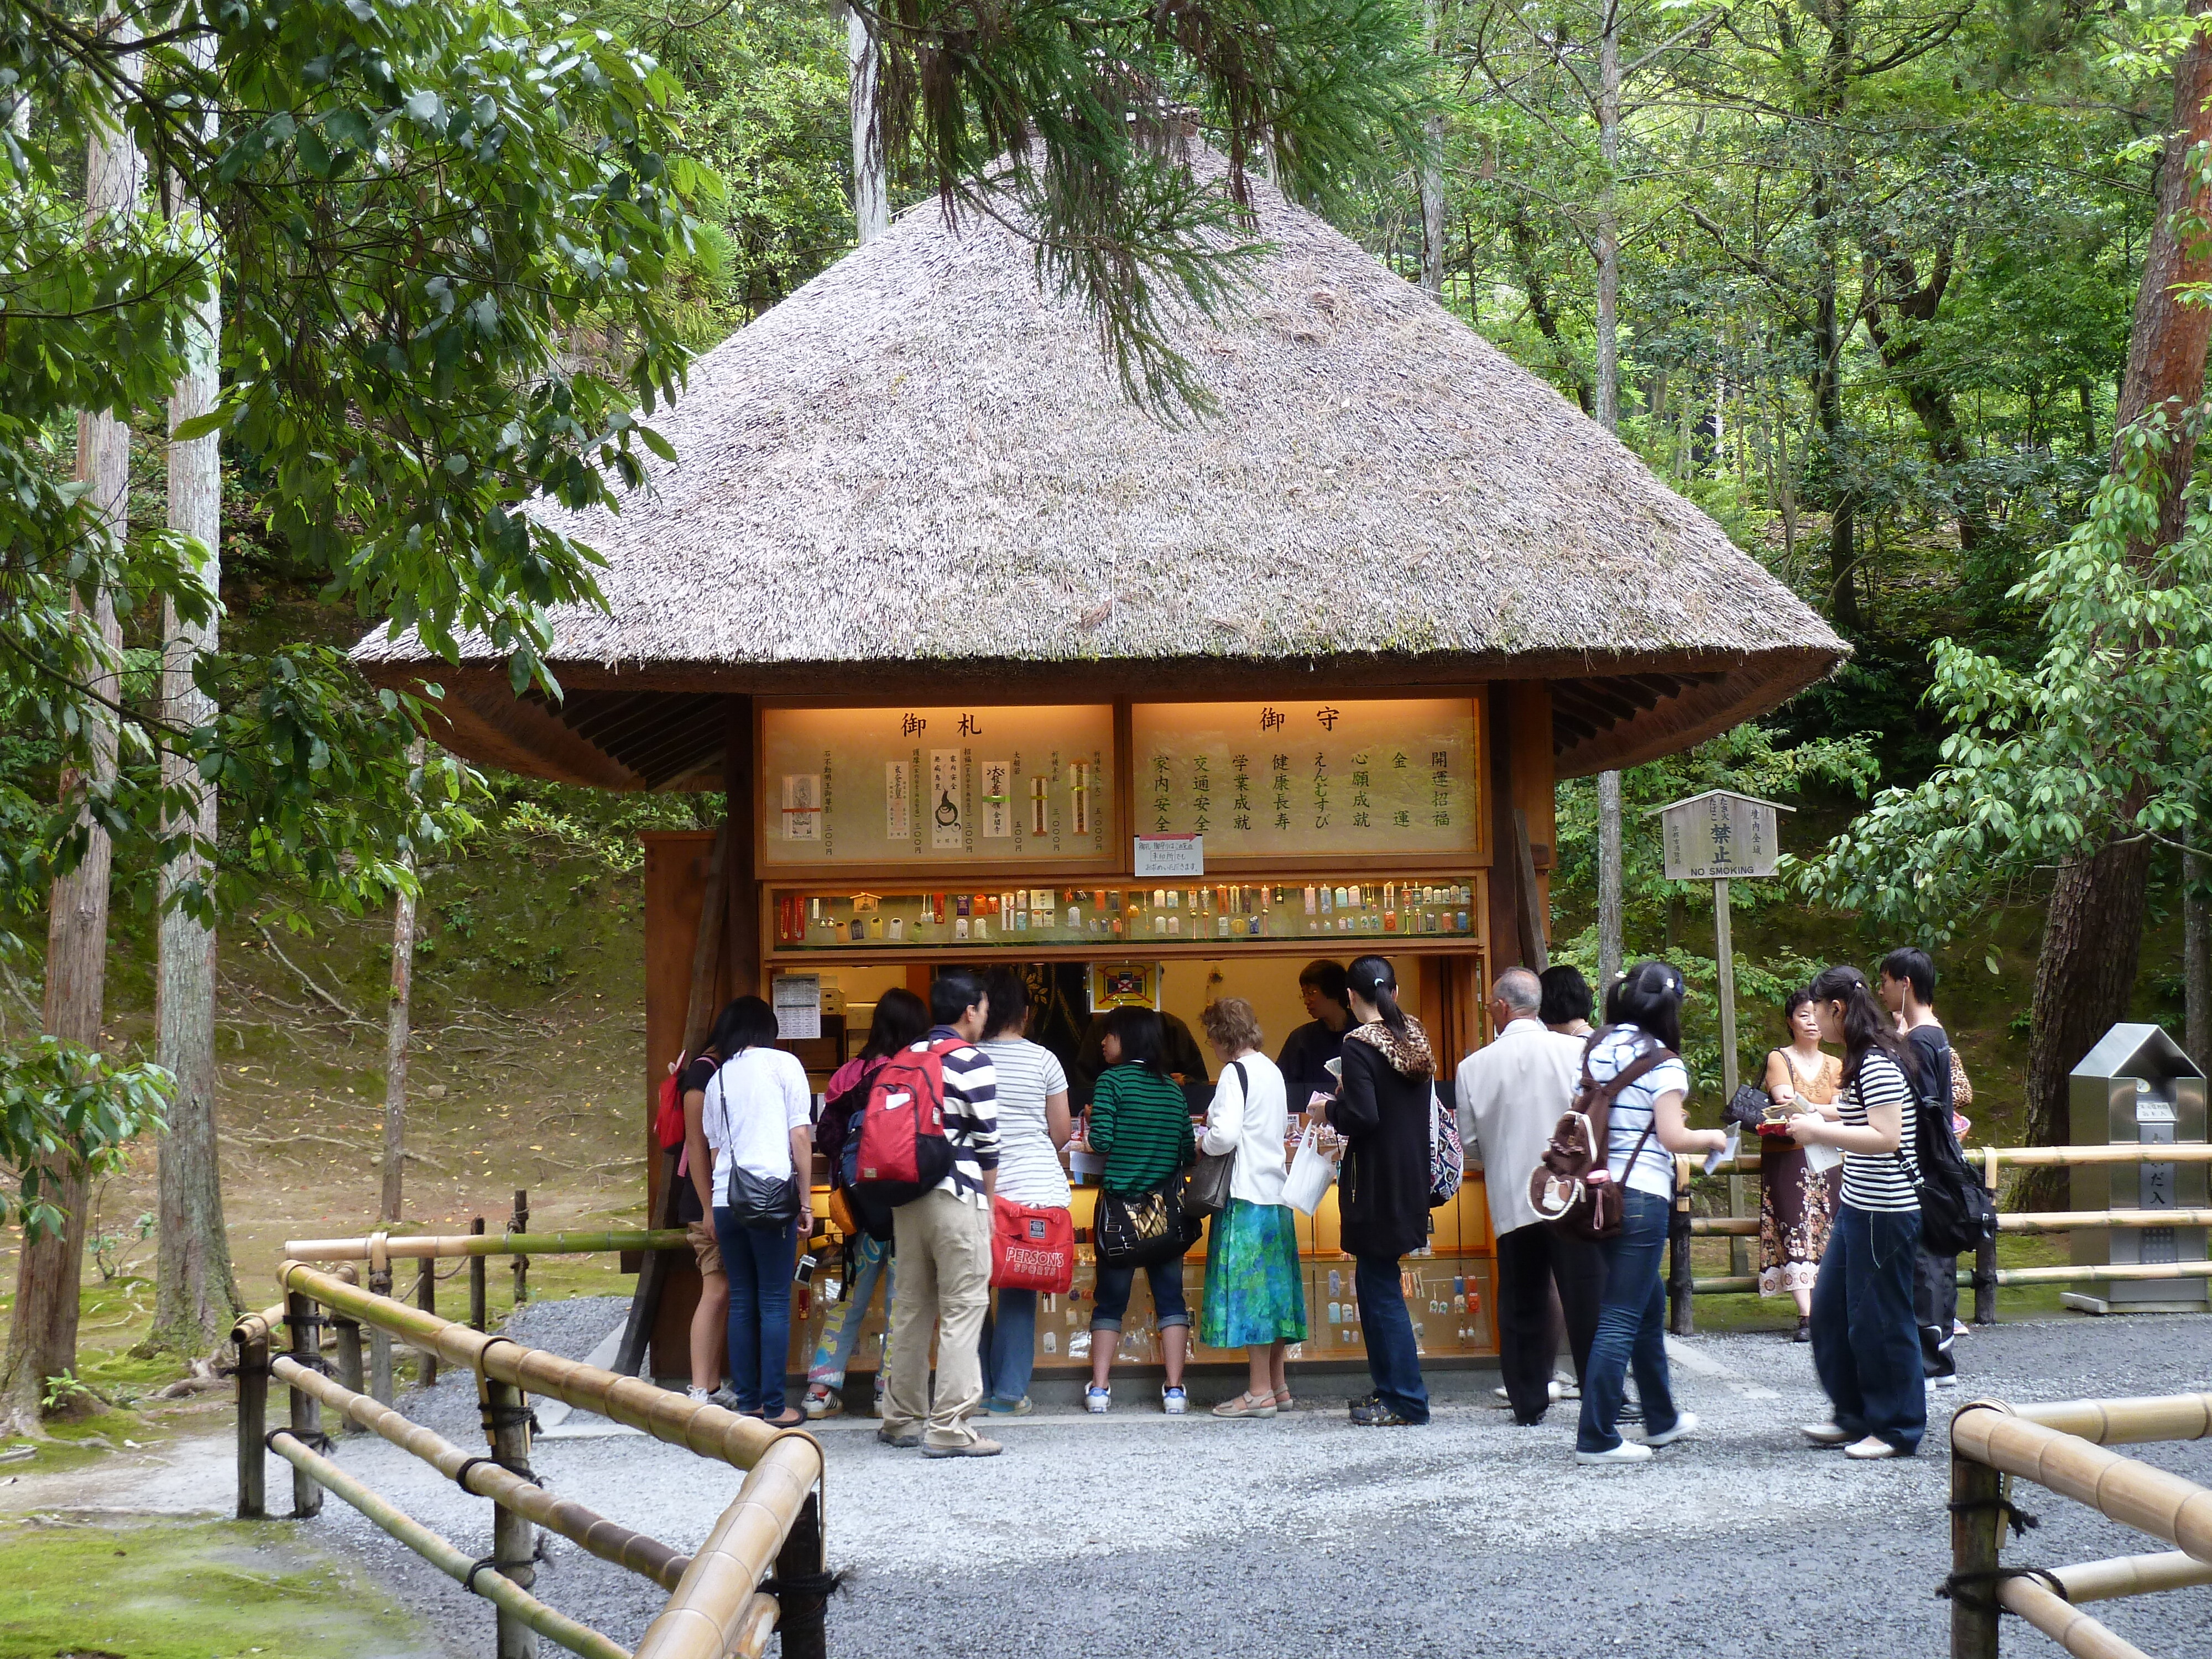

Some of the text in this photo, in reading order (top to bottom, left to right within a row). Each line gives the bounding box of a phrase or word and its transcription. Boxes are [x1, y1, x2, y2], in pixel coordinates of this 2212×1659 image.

[901, 712, 982, 738] 御札
[1259, 706, 1340, 733] 御守
[1013, 751, 1021, 775] 大般若
[1153, 755, 1172, 834] 家内安全
[1192, 754, 1211, 832] 交通安全
[1232, 754, 1251, 831] 学業成就
[1272, 753, 1291, 831] 健康長寿
[1313, 752, 1329, 830] えんむすび
[1351, 753, 1370, 828] 心願成就
[1392, 751, 1410, 828] 金運
[1431, 751, 1450, 827] 開運招福
[1720, 797, 1729, 821] たき火
[1710, 823, 1733, 864] 禁止
[1751, 808, 1761, 855] 境内全域
[1691, 866, 1754, 877] NO SMOKING
[1005, 1246, 1065, 1268] PERSON'S
[1013, 1262, 1057, 1277] SPORTS
